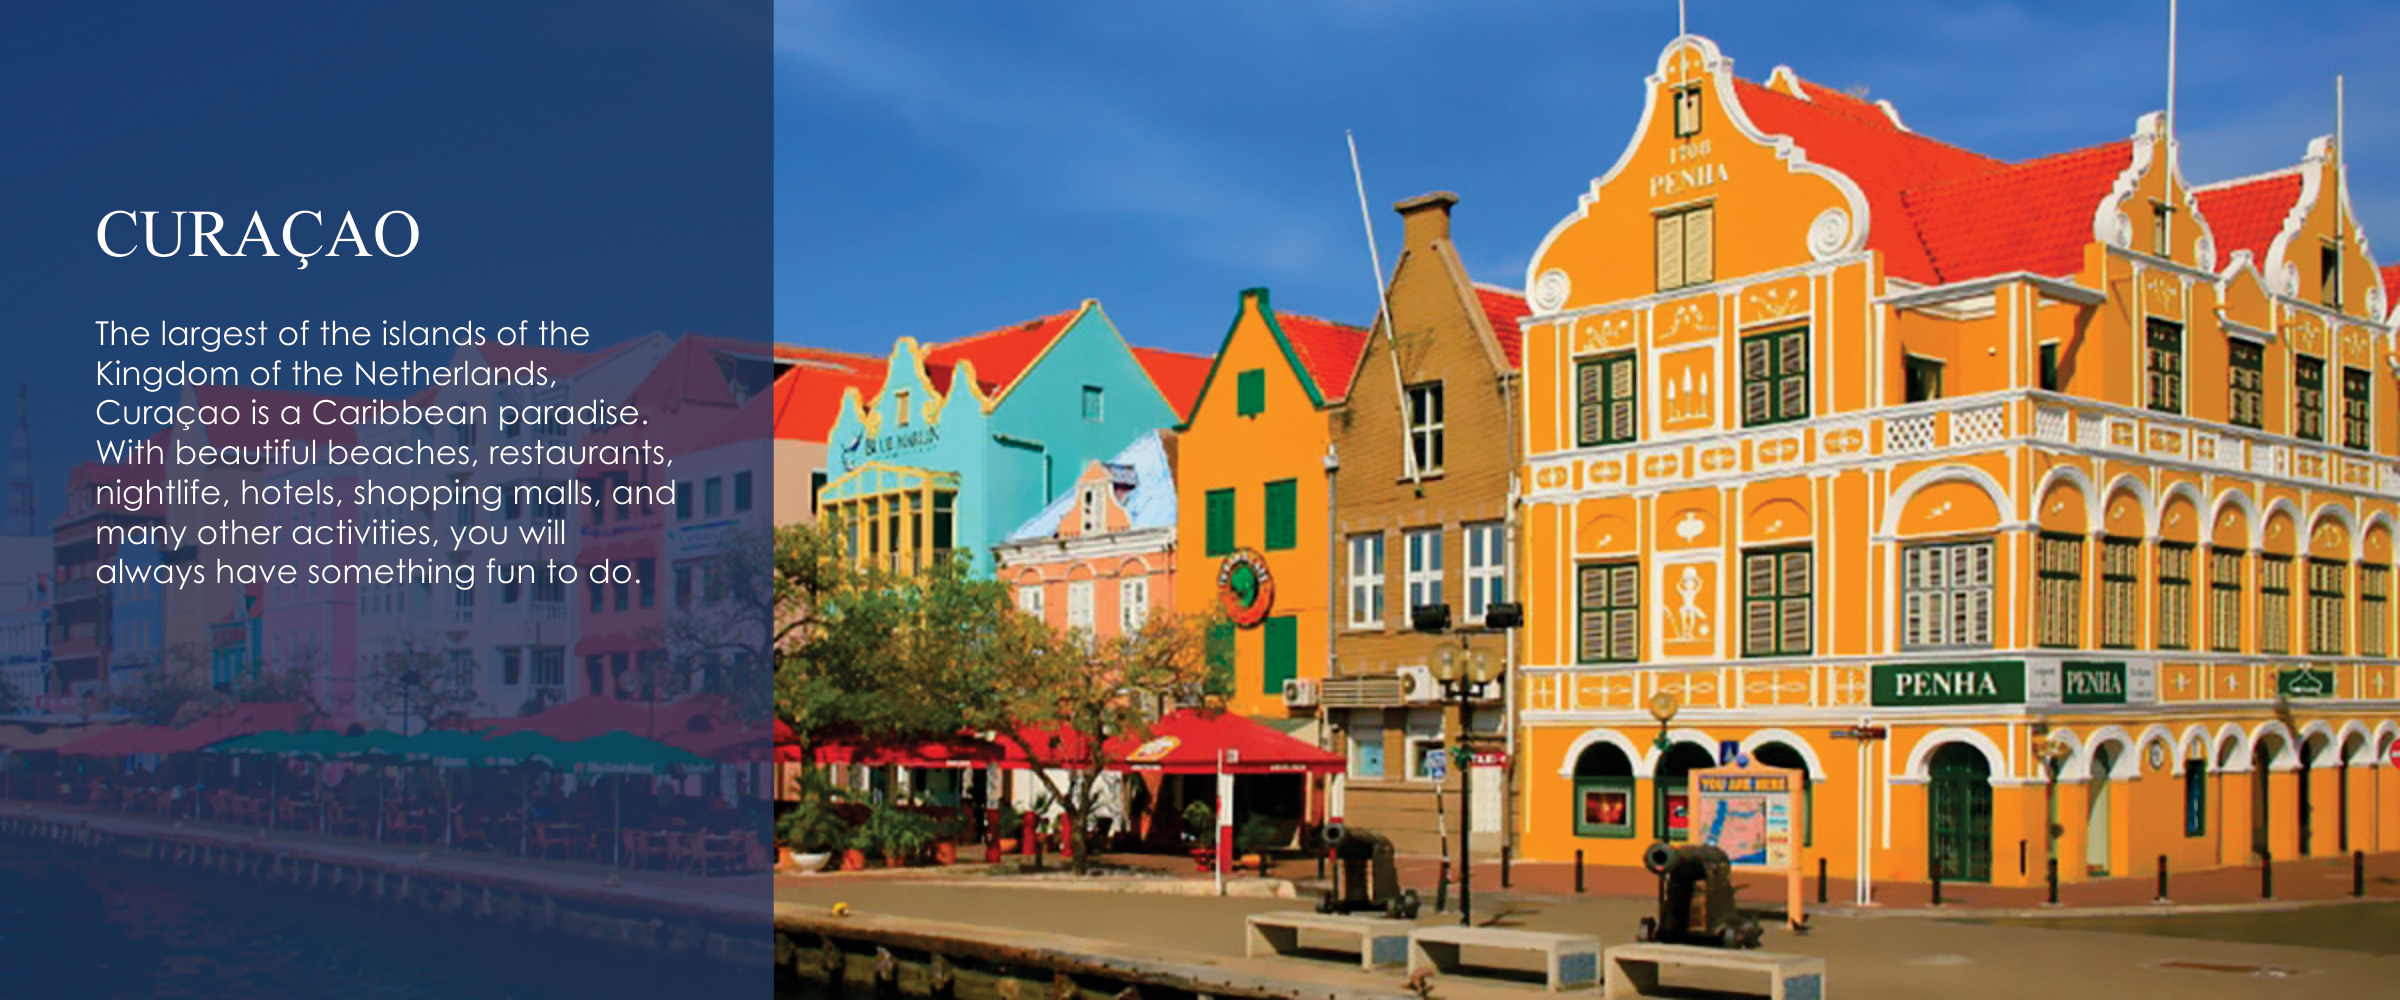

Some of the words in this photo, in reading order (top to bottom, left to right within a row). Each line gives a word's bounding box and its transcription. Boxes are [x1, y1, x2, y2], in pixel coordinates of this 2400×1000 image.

[1649, 163, 1729, 198] PENHA
[1895, 671, 1998, 697] PENHA
[2067, 670, 2122, 694] PENHA
